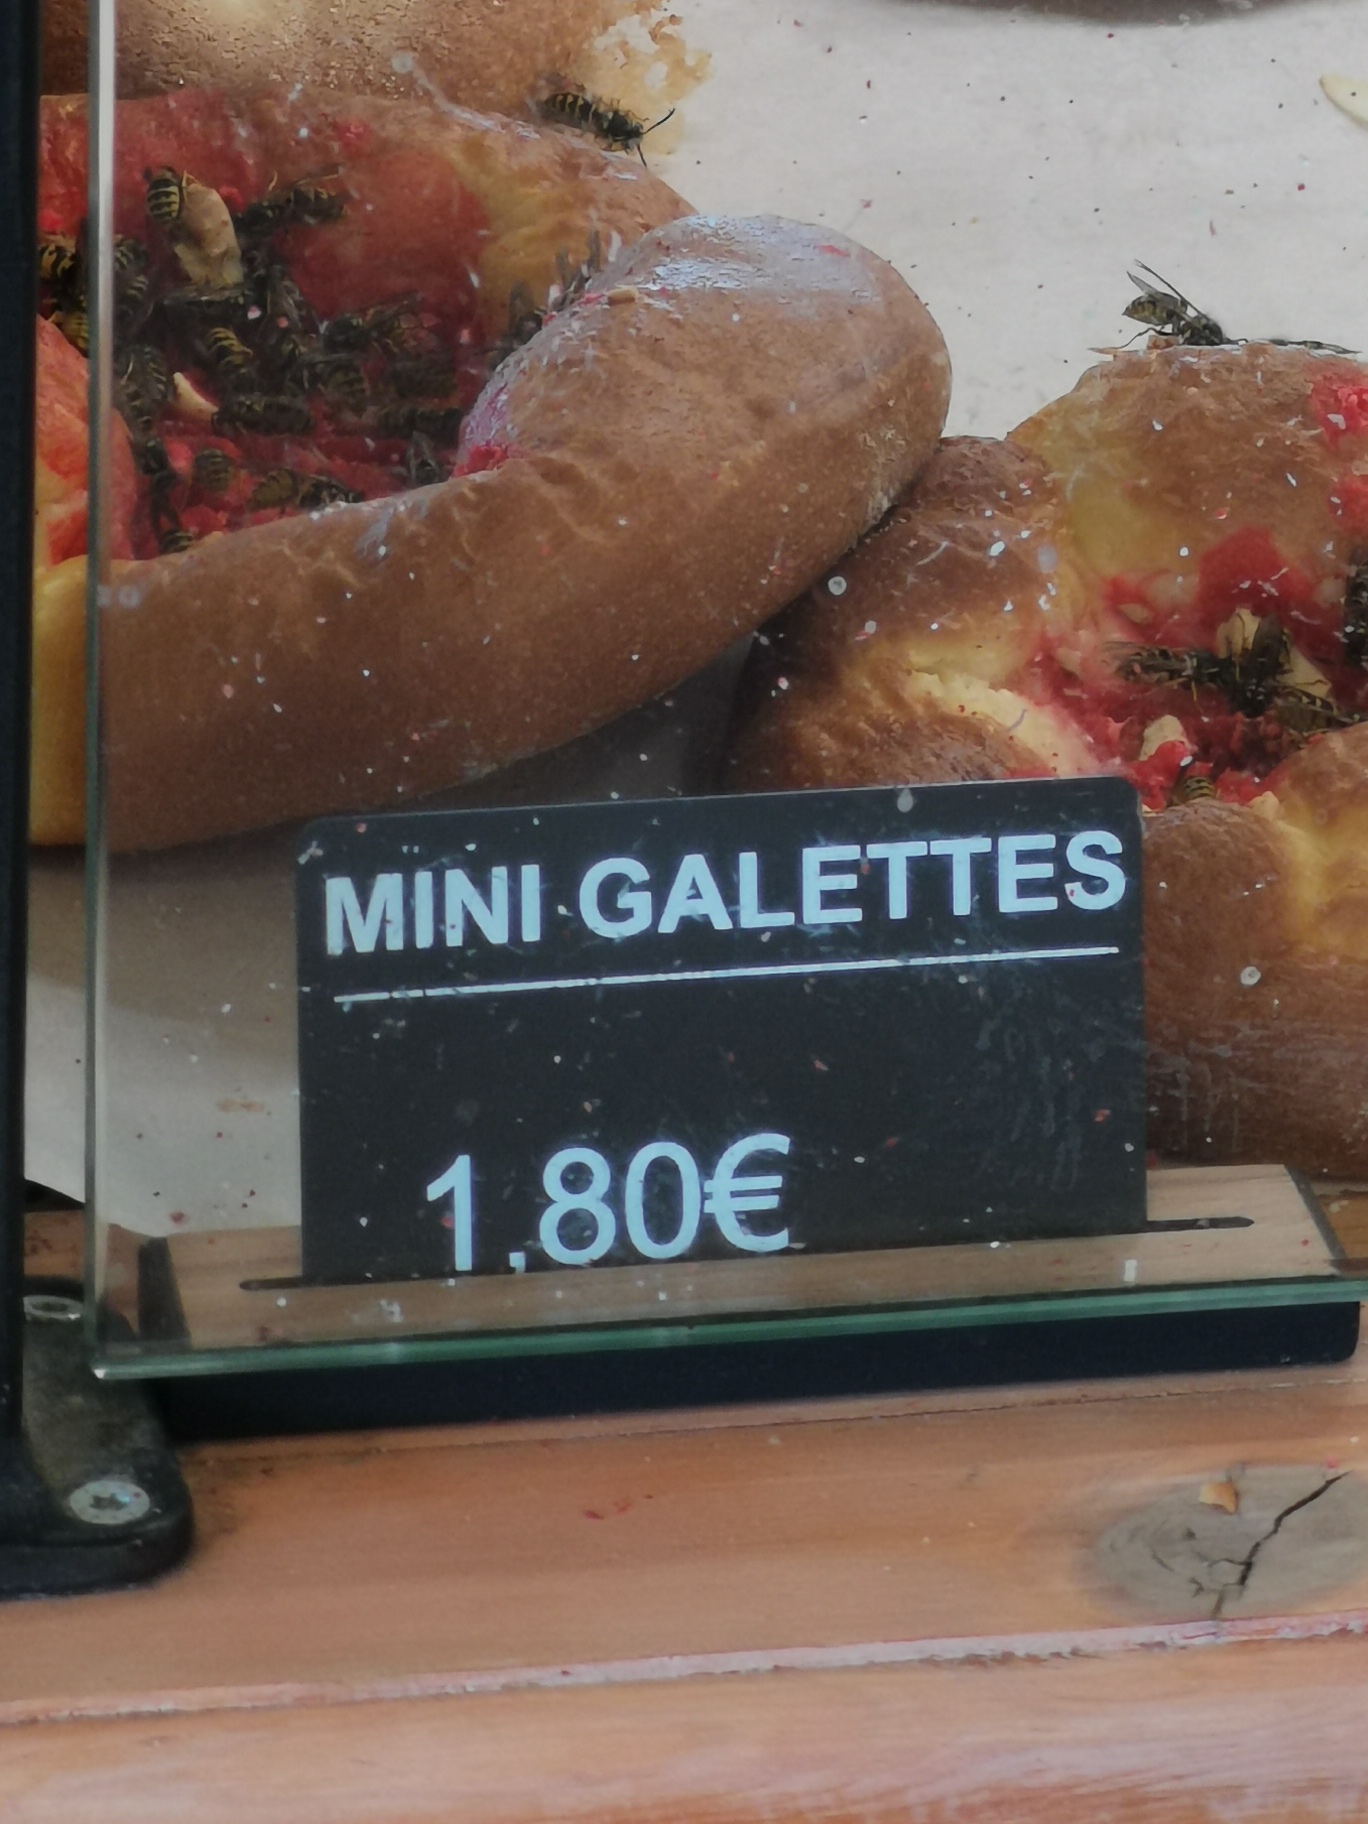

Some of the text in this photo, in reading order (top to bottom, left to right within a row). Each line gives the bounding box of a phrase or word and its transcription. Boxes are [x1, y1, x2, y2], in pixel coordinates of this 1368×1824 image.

[324, 829, 1127, 956] MINI GALETTES
[425, 1132, 791, 1273] 1,80€
